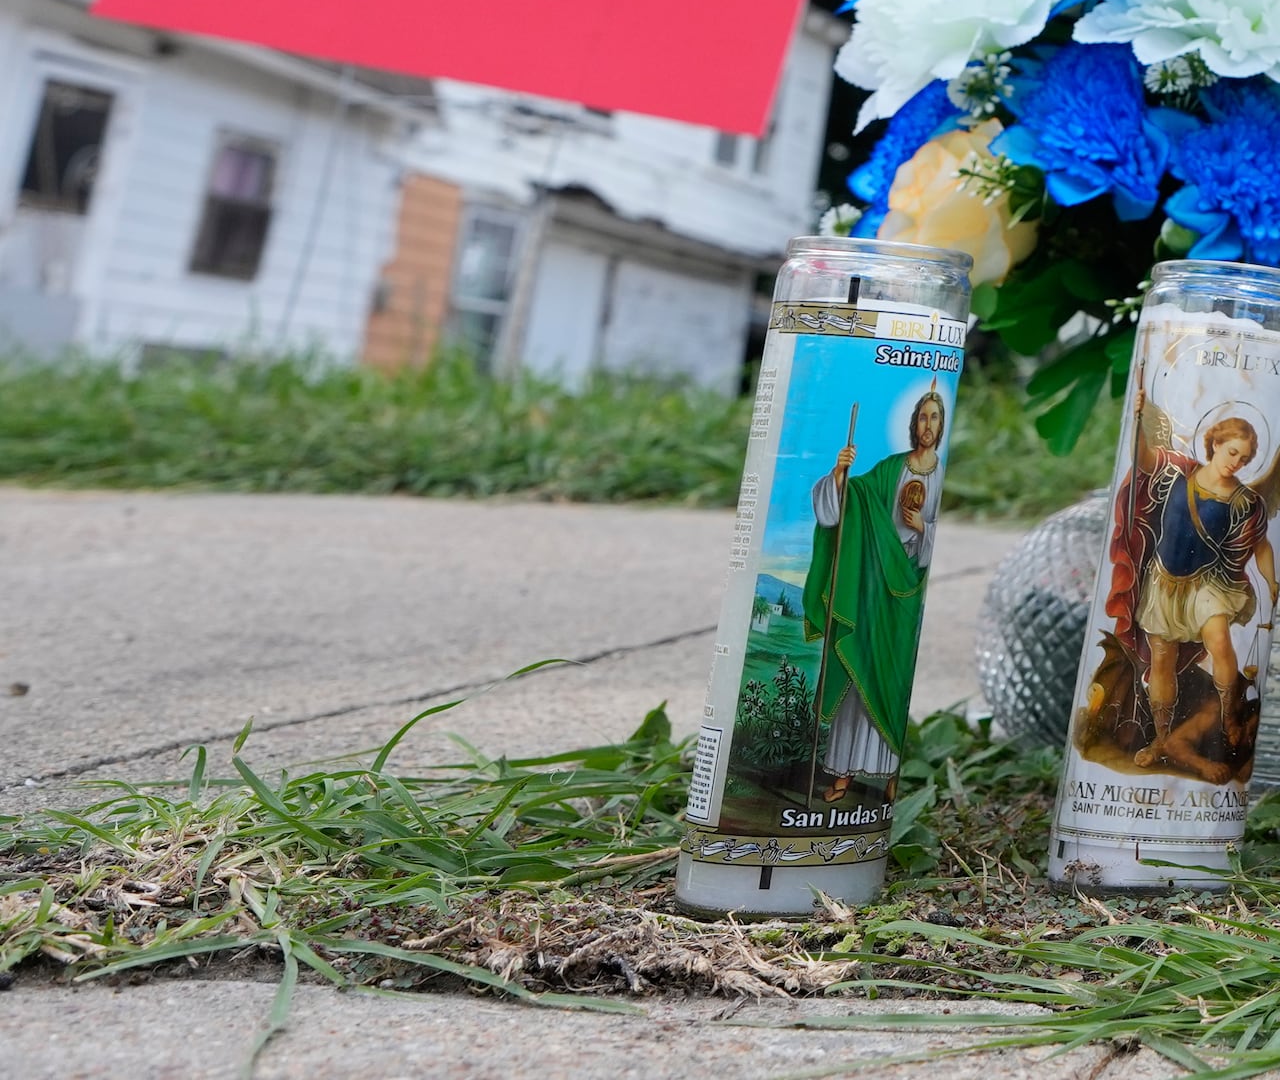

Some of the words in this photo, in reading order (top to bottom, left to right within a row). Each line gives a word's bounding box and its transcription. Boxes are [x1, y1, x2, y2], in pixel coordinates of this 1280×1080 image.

[876, 344, 933, 368] Saint
[932, 349, 961, 372] Jude
[1068, 780, 1097, 799] SAN
[1100, 784, 1174, 807] MIGUEL
[780, 808, 824, 828] San
[828, 804, 878, 828] Judas
[1072, 801, 1101, 814] SAINT
[1103, 805, 1161, 820] MICHAEL
[1167, 809, 1191, 821] THE
